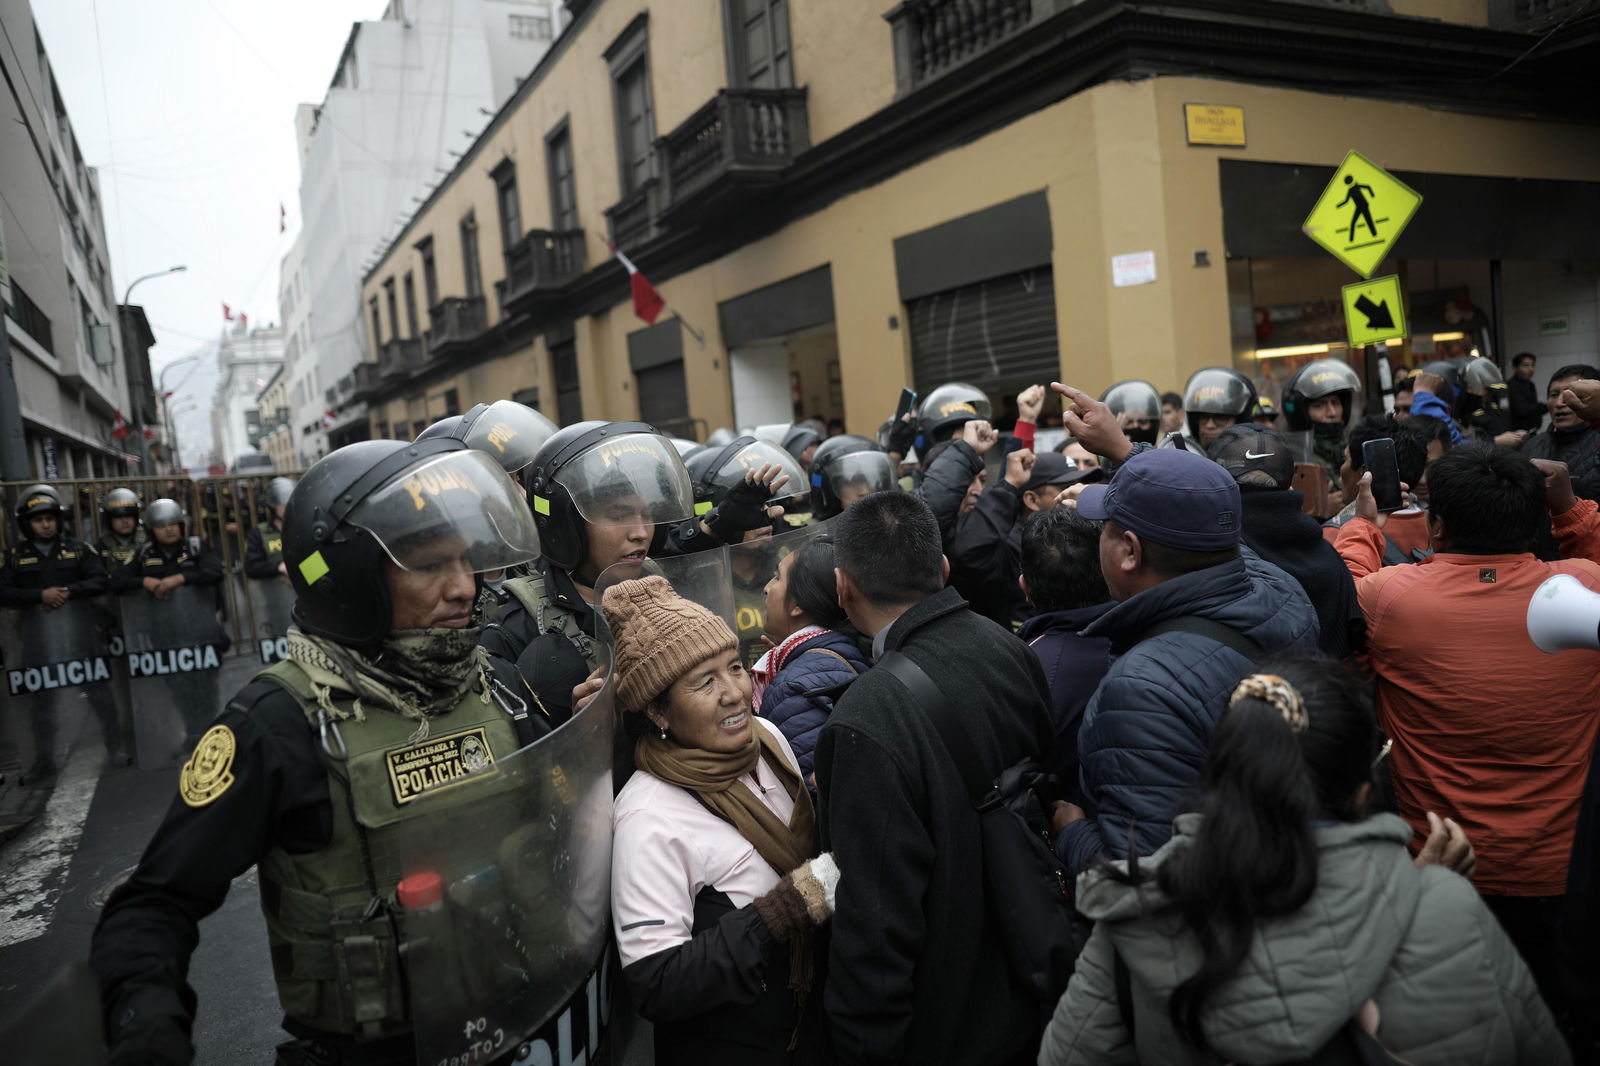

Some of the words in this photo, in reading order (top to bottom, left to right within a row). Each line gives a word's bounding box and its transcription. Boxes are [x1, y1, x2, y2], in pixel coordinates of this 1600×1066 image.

[9, 657, 110, 694] POLICIA
[128, 644, 220, 677] POLICIA
[398, 759, 466, 796] POLICIA
